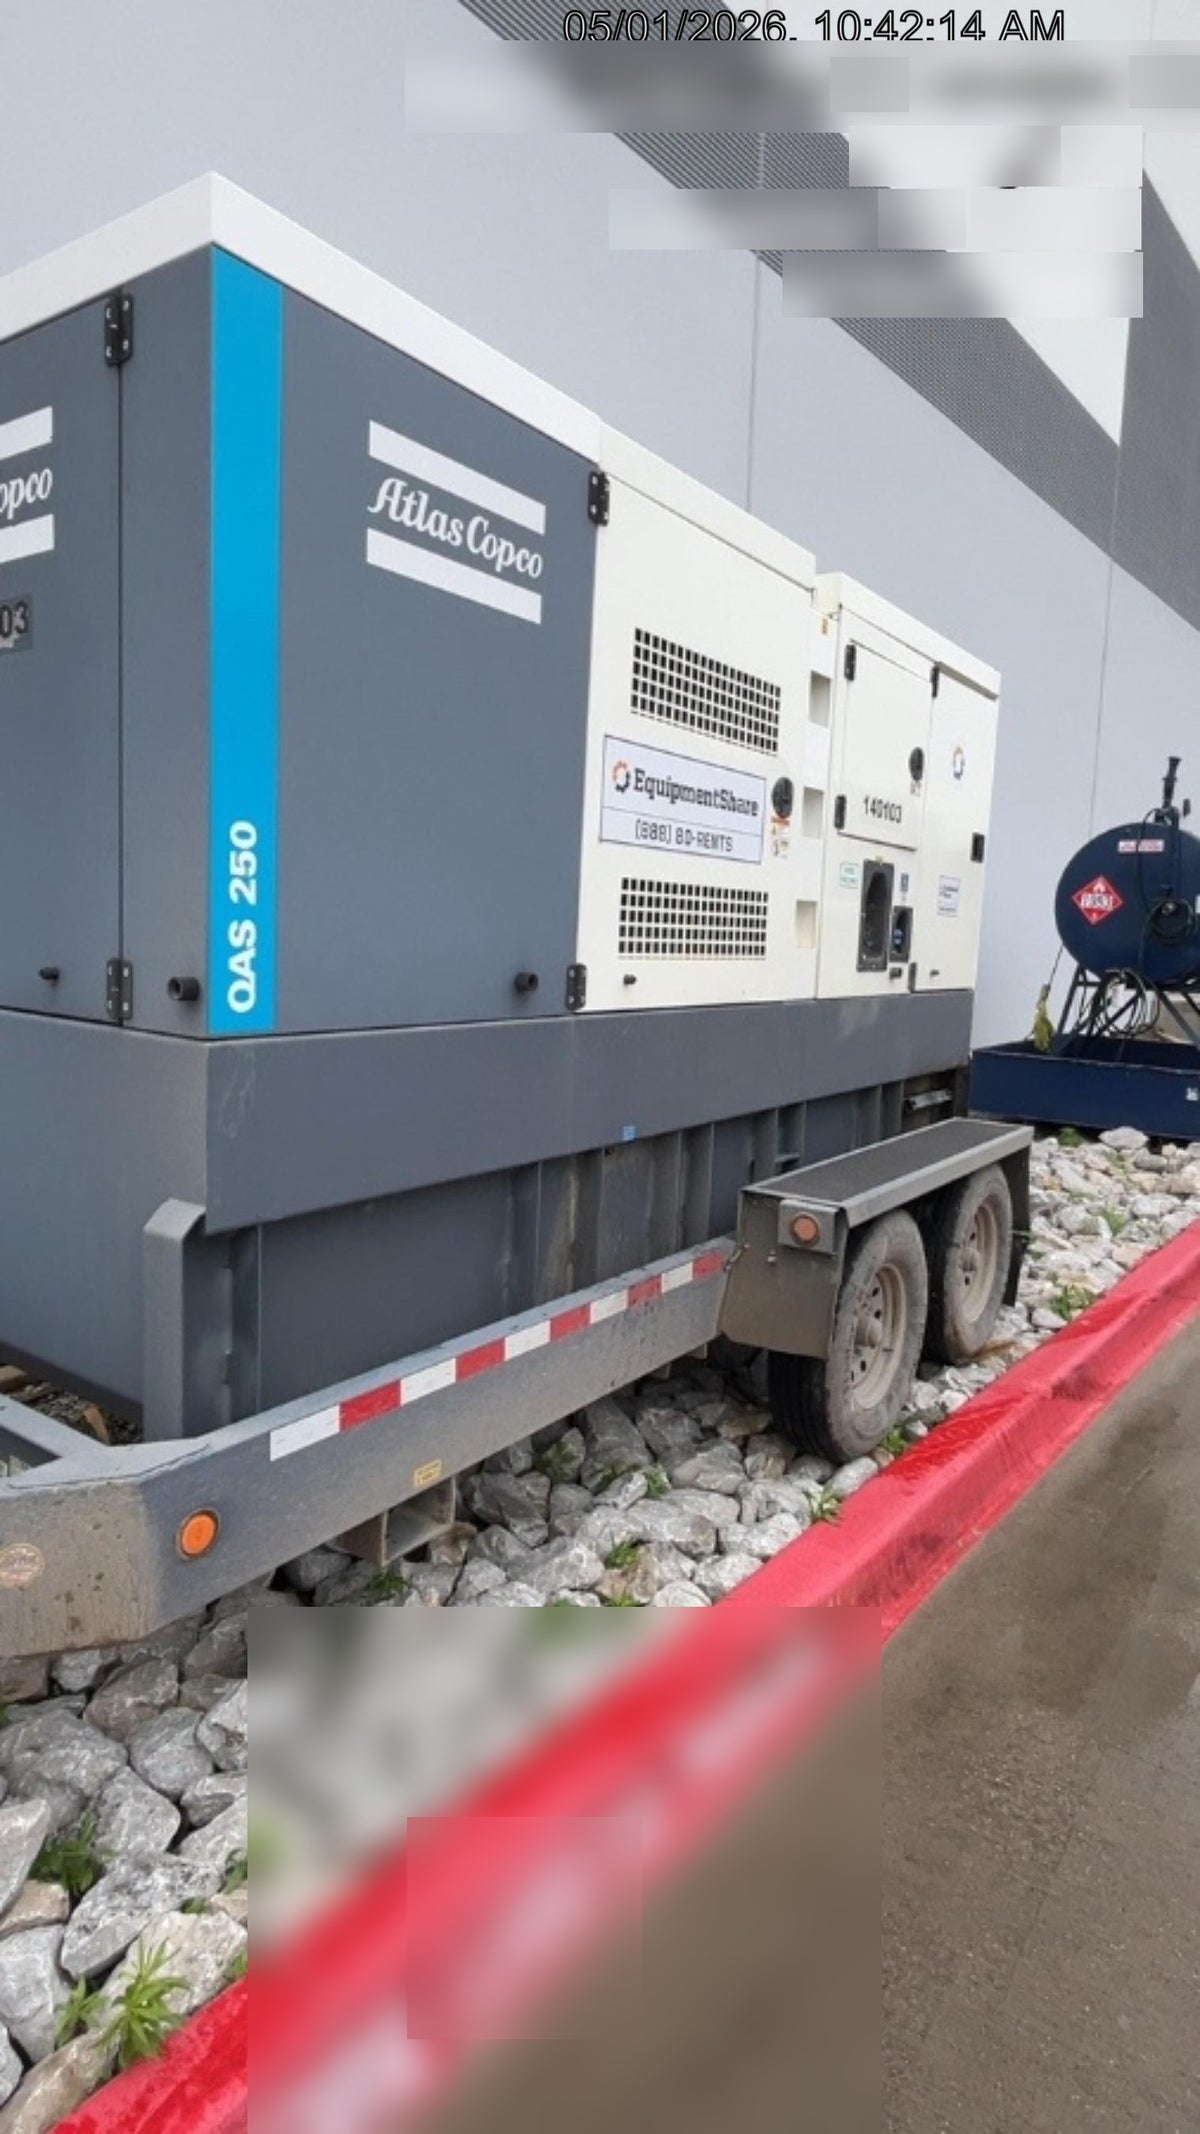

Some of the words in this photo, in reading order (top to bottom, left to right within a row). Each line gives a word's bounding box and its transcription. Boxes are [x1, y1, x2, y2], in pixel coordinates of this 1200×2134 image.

[366, 477, 465, 547] Atlas
[466, 515, 544, 579] Copco
[632, 767, 759, 817] EquipmentShare
[863, 795, 903, 824] 140103
[228, 819, 258, 906] 250
[226, 919, 258, 1014] QAS
